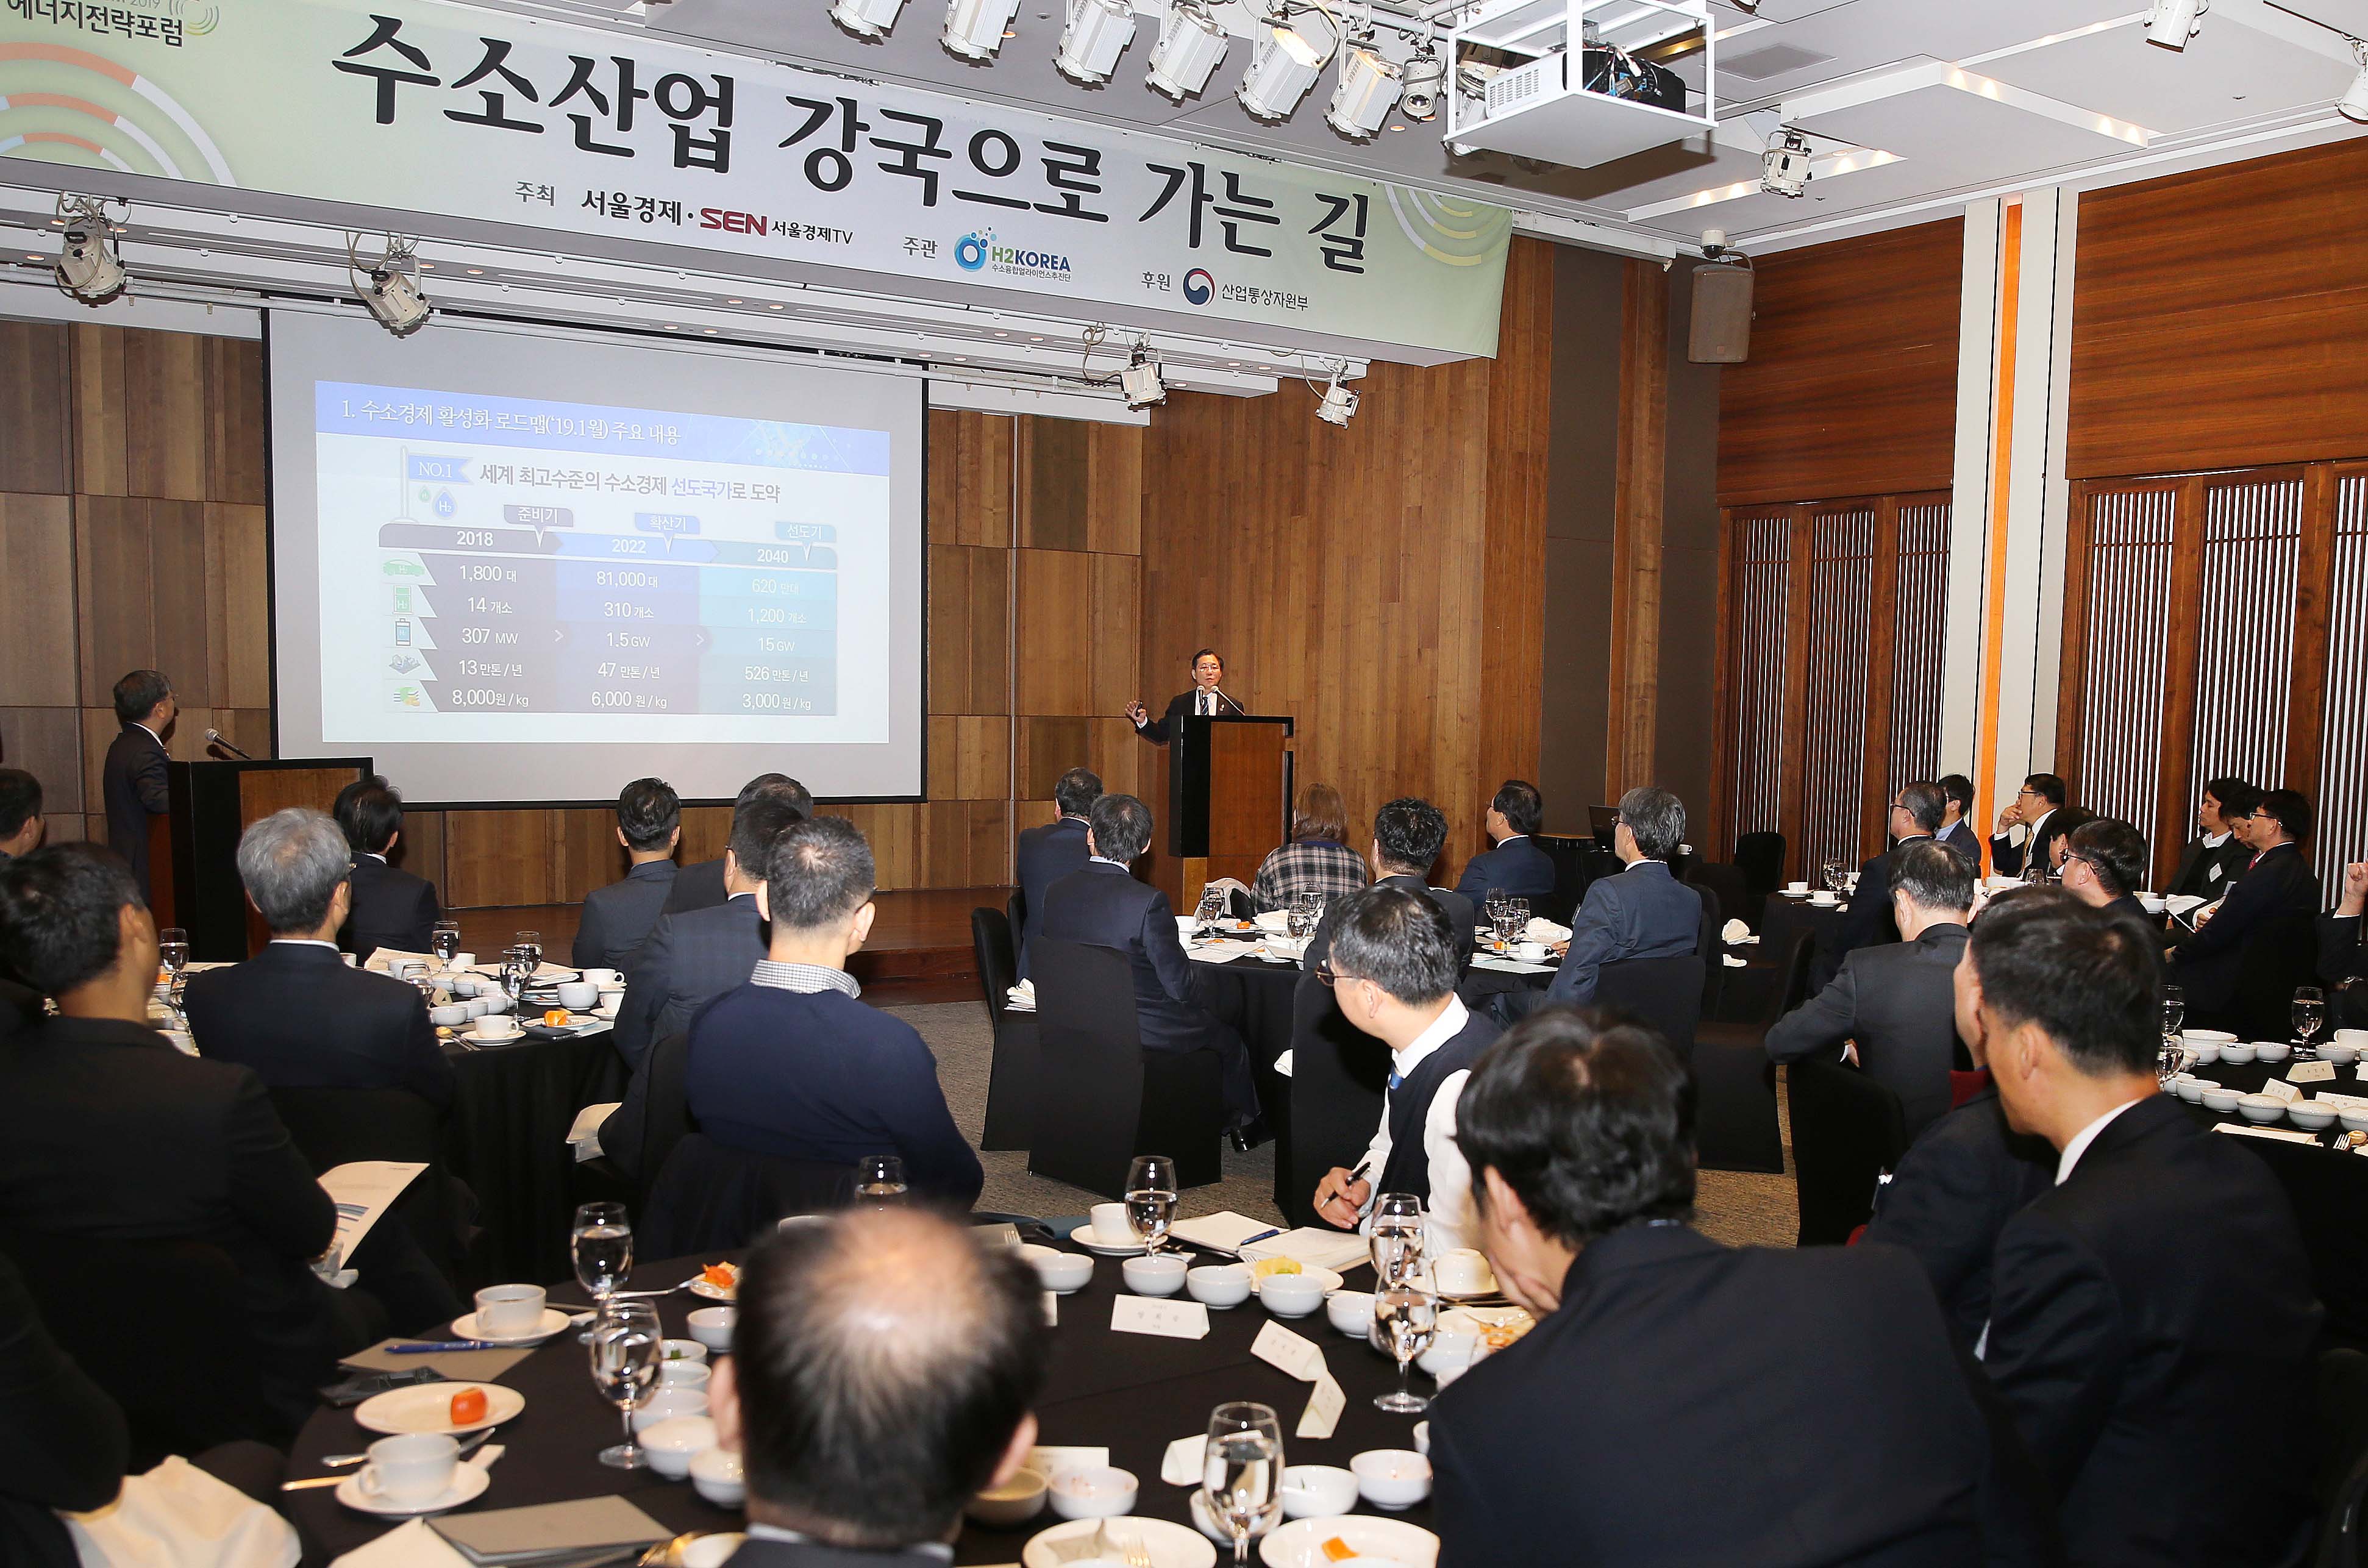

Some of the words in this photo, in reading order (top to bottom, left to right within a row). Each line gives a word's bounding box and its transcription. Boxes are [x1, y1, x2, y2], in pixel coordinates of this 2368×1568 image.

[7, 0, 183, 47] 에너지전략포럼
[332, 14, 735, 173] 수소산업
[778, 96, 1109, 223] 강국으로
[1138, 162, 1282, 257] 가는
[1308, 193, 1370, 274] 길
[515, 182, 554, 206] 주최
[701, 208, 767, 236] SEN
[772, 221, 853, 244] 서울경제TV
[903, 237, 938, 259] 주관
[992, 246, 1071, 272] H2KOREA
[992, 265, 1071, 282] 수소융합얼라이언스추진단
[1141, 271, 1171, 291] 후원
[1222, 283, 1308, 311] 산업통상자원부
[343, 400, 355, 418] 1.
[361, 400, 432, 426] 수소경제
[438, 406, 493, 430] 활성화
[612, 422, 645, 441] 주요
[649, 424, 682, 446] 내용
[418, 462, 452, 478] NO.1
[480, 465, 513, 485] 세계
[519, 467, 600, 491] 최고수준의
[604, 472, 667, 496] 수소경제
[672, 477, 747, 500] 선도국가로
[751, 483, 780, 504] 도약
[518, 507, 558, 524] 준비기
[649, 515, 687, 532] 확산기
[457, 531, 493, 547] 2018
[787, 524, 822, 540] 선도기
[612, 539, 646, 554] 2022
[757, 549, 788, 563] 2040
[460, 565, 502, 582] 1,800
[596, 571, 646, 588] 81,000
[752, 579, 777, 594] 620
[468, 597, 487, 613] 14
[490, 601, 513, 615] 개소
[604, 602, 632, 618] 310
[633, 606, 654, 619] 개소
[747, 608, 785, 625] 1,200
[788, 612, 807, 624] 개소
[462, 627, 491, 644] 307
[495, 633, 519, 644] MW
[607, 632, 629, 647] 1.5
[631, 636, 651, 647] GW
[758, 637, 774, 652] 15
[777, 641, 795, 652] GW
[597, 662, 616, 677] 47
[591, 691, 632, 708] 6,000
